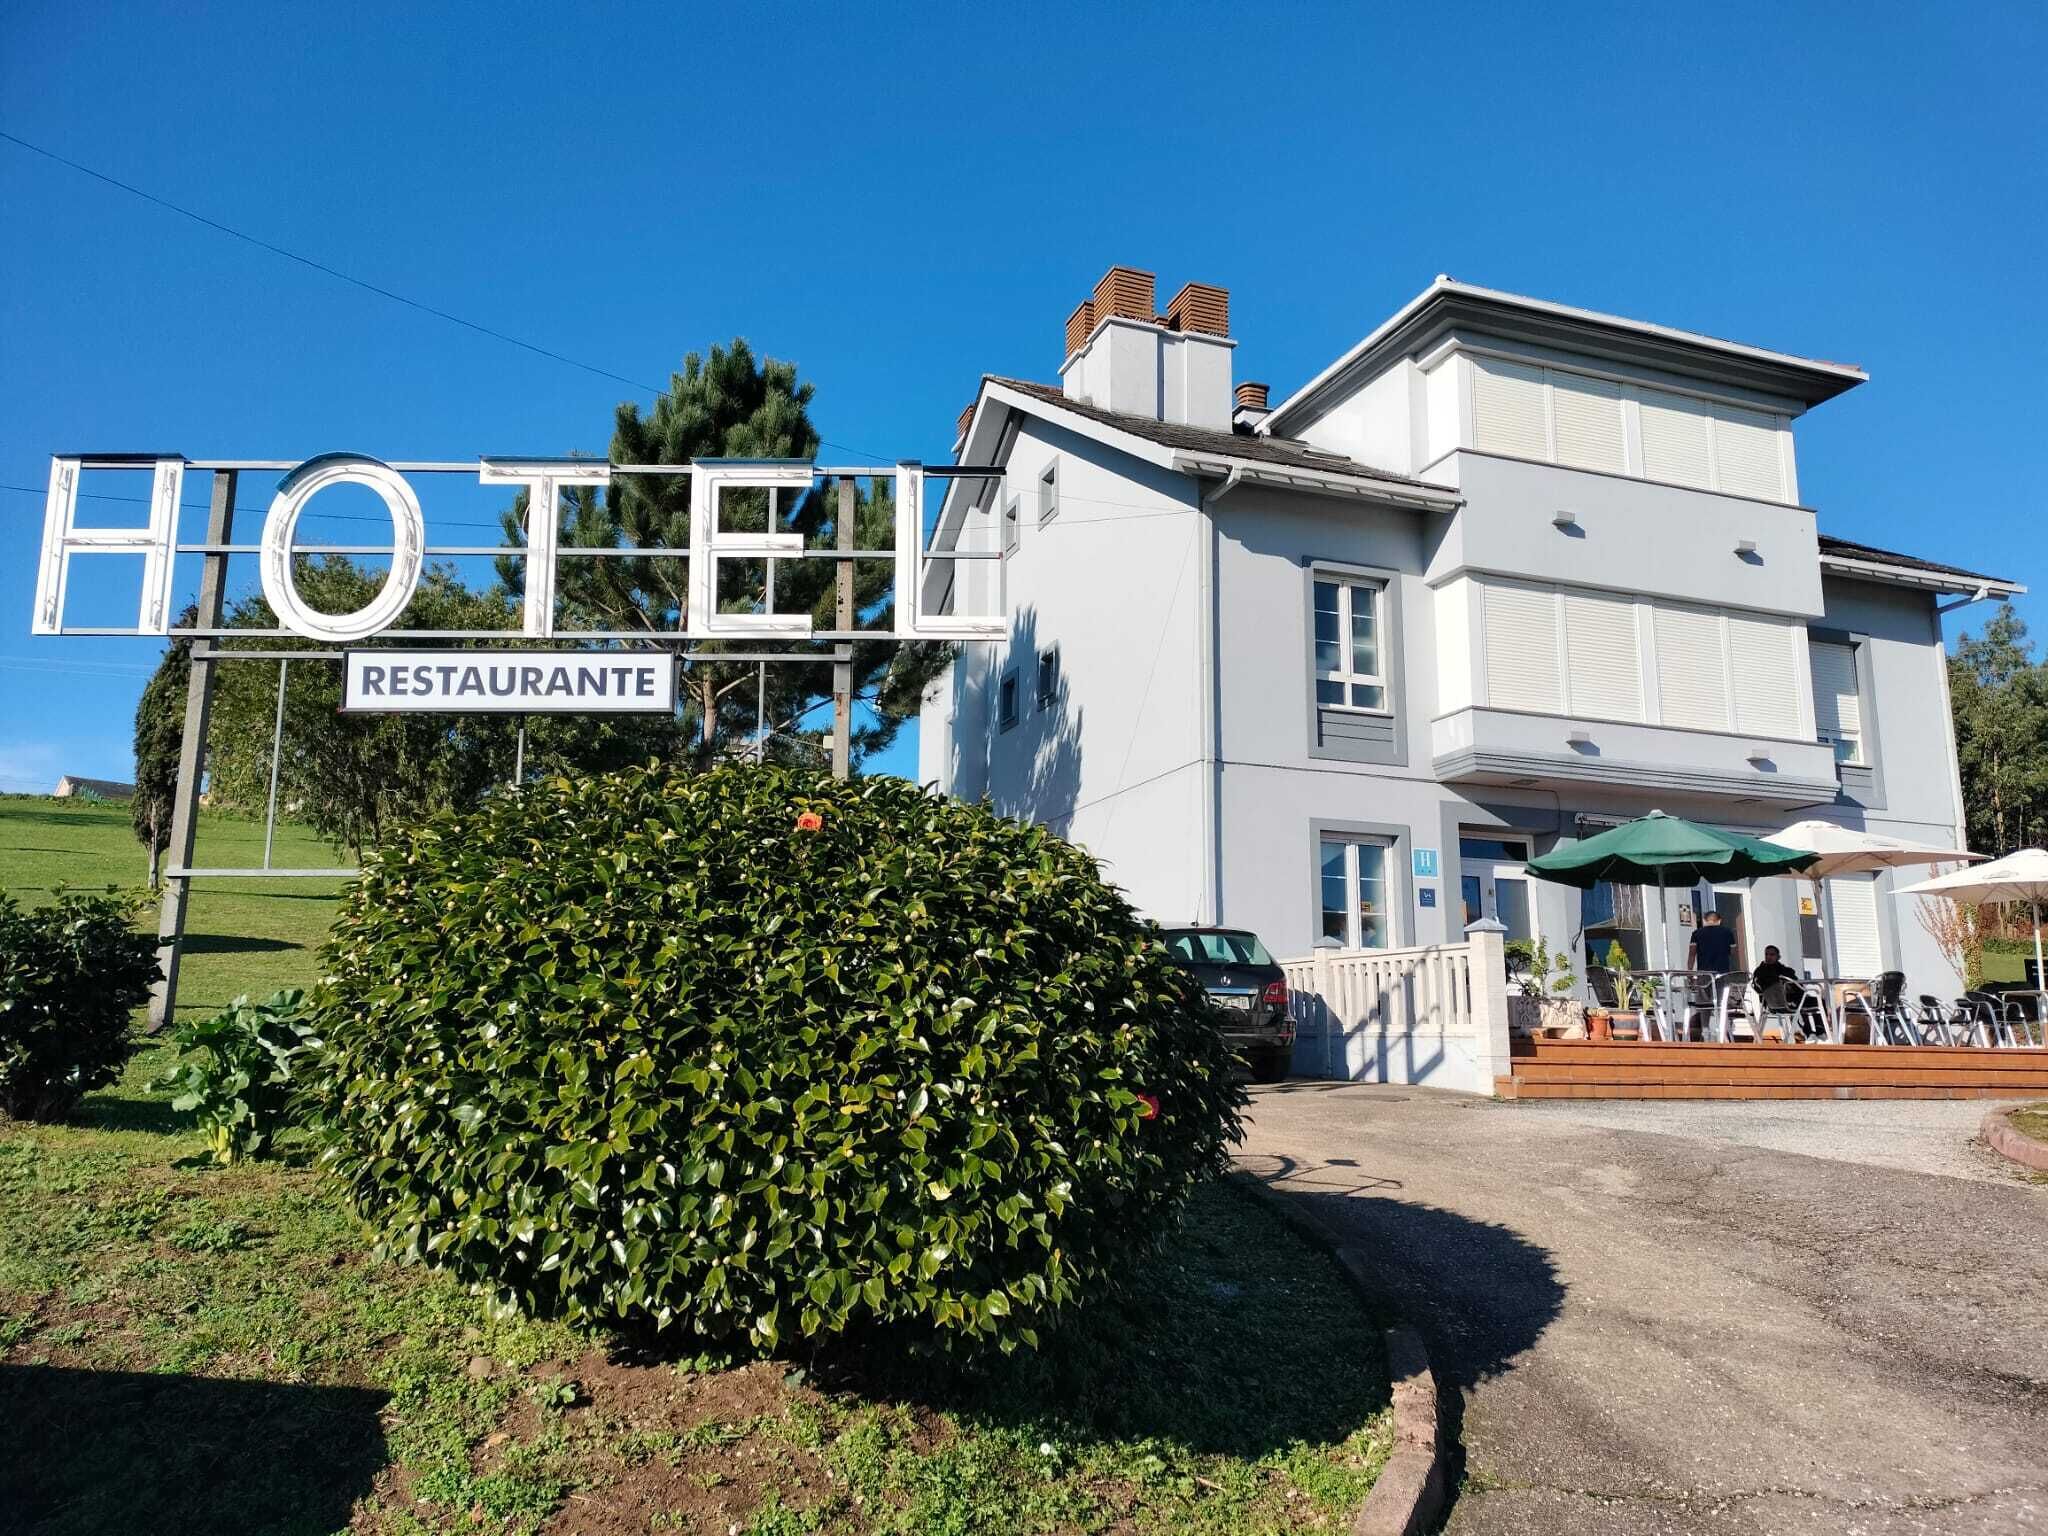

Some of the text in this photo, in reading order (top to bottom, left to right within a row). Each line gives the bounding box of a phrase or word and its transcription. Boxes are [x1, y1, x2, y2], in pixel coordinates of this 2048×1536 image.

[31, 454, 1008, 642] HOTEL
[363, 665, 655, 697] RESTAURANTE
[1420, 851, 1432, 868] H
